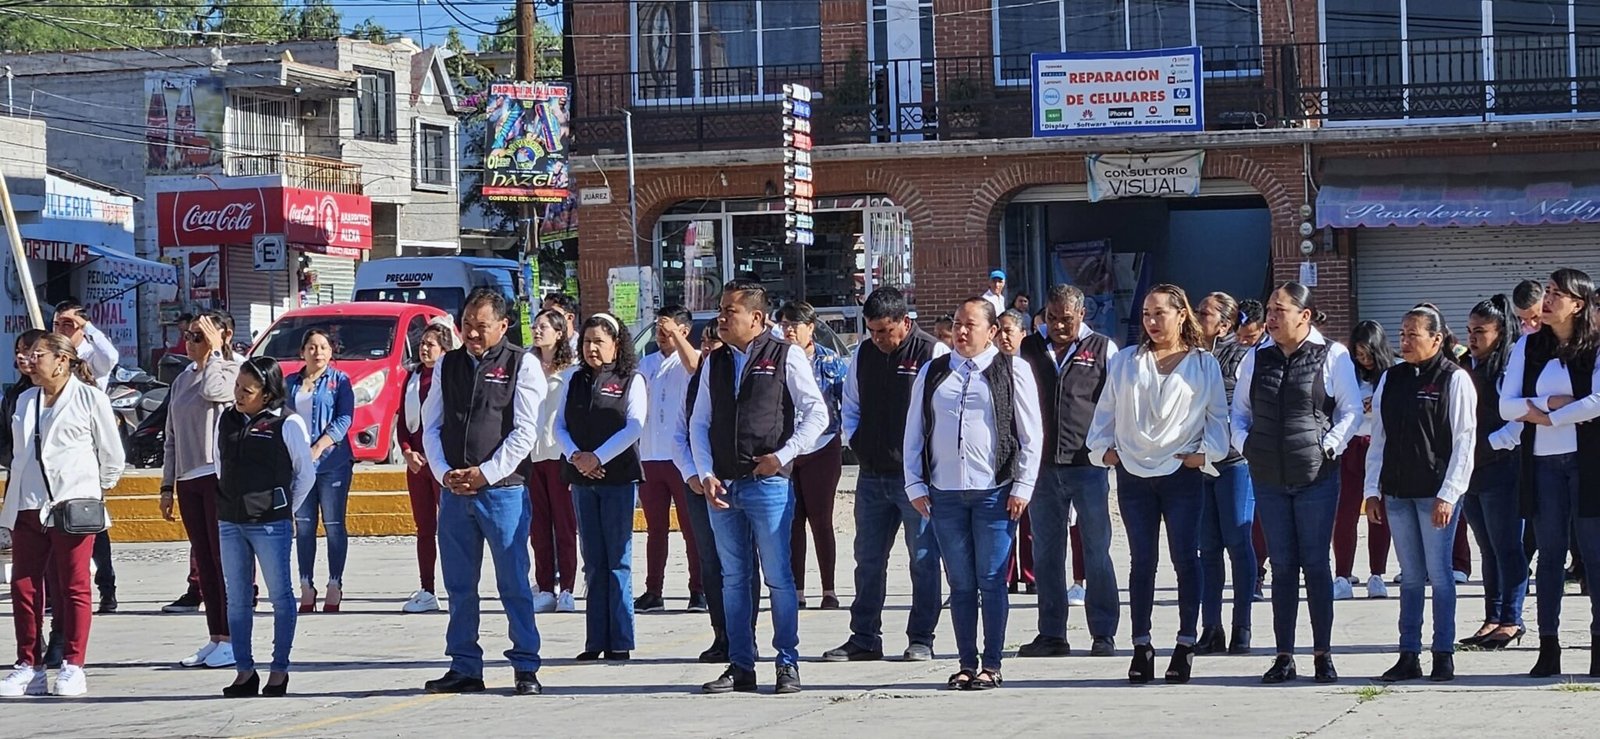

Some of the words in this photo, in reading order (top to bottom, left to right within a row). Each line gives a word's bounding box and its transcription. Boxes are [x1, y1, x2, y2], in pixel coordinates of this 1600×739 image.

[1069, 67, 1159, 84] REPARACIÓN
[1066, 94, 1084, 105] DE
[1089, 90, 1166, 104] CELULARES
[1104, 167, 1188, 178] CONSULTORIO
[1108, 177, 1185, 195] VISUAL
[583, 191, 608, 200] JUÁREZ
[47, 194, 93, 218] ILLERIA
[1344, 203, 1493, 219] Pasteleria
[1509, 198, 1600, 220] Nelly
[182, 202, 256, 232] Coca-Cola
[24, 239, 89, 264] ORTILLAS
[263, 243, 277, 262] E
[87, 270, 120, 285] PEDIDOS
[385, 272, 434, 283] PRECAUCION
[4, 314, 29, 334] HARI
